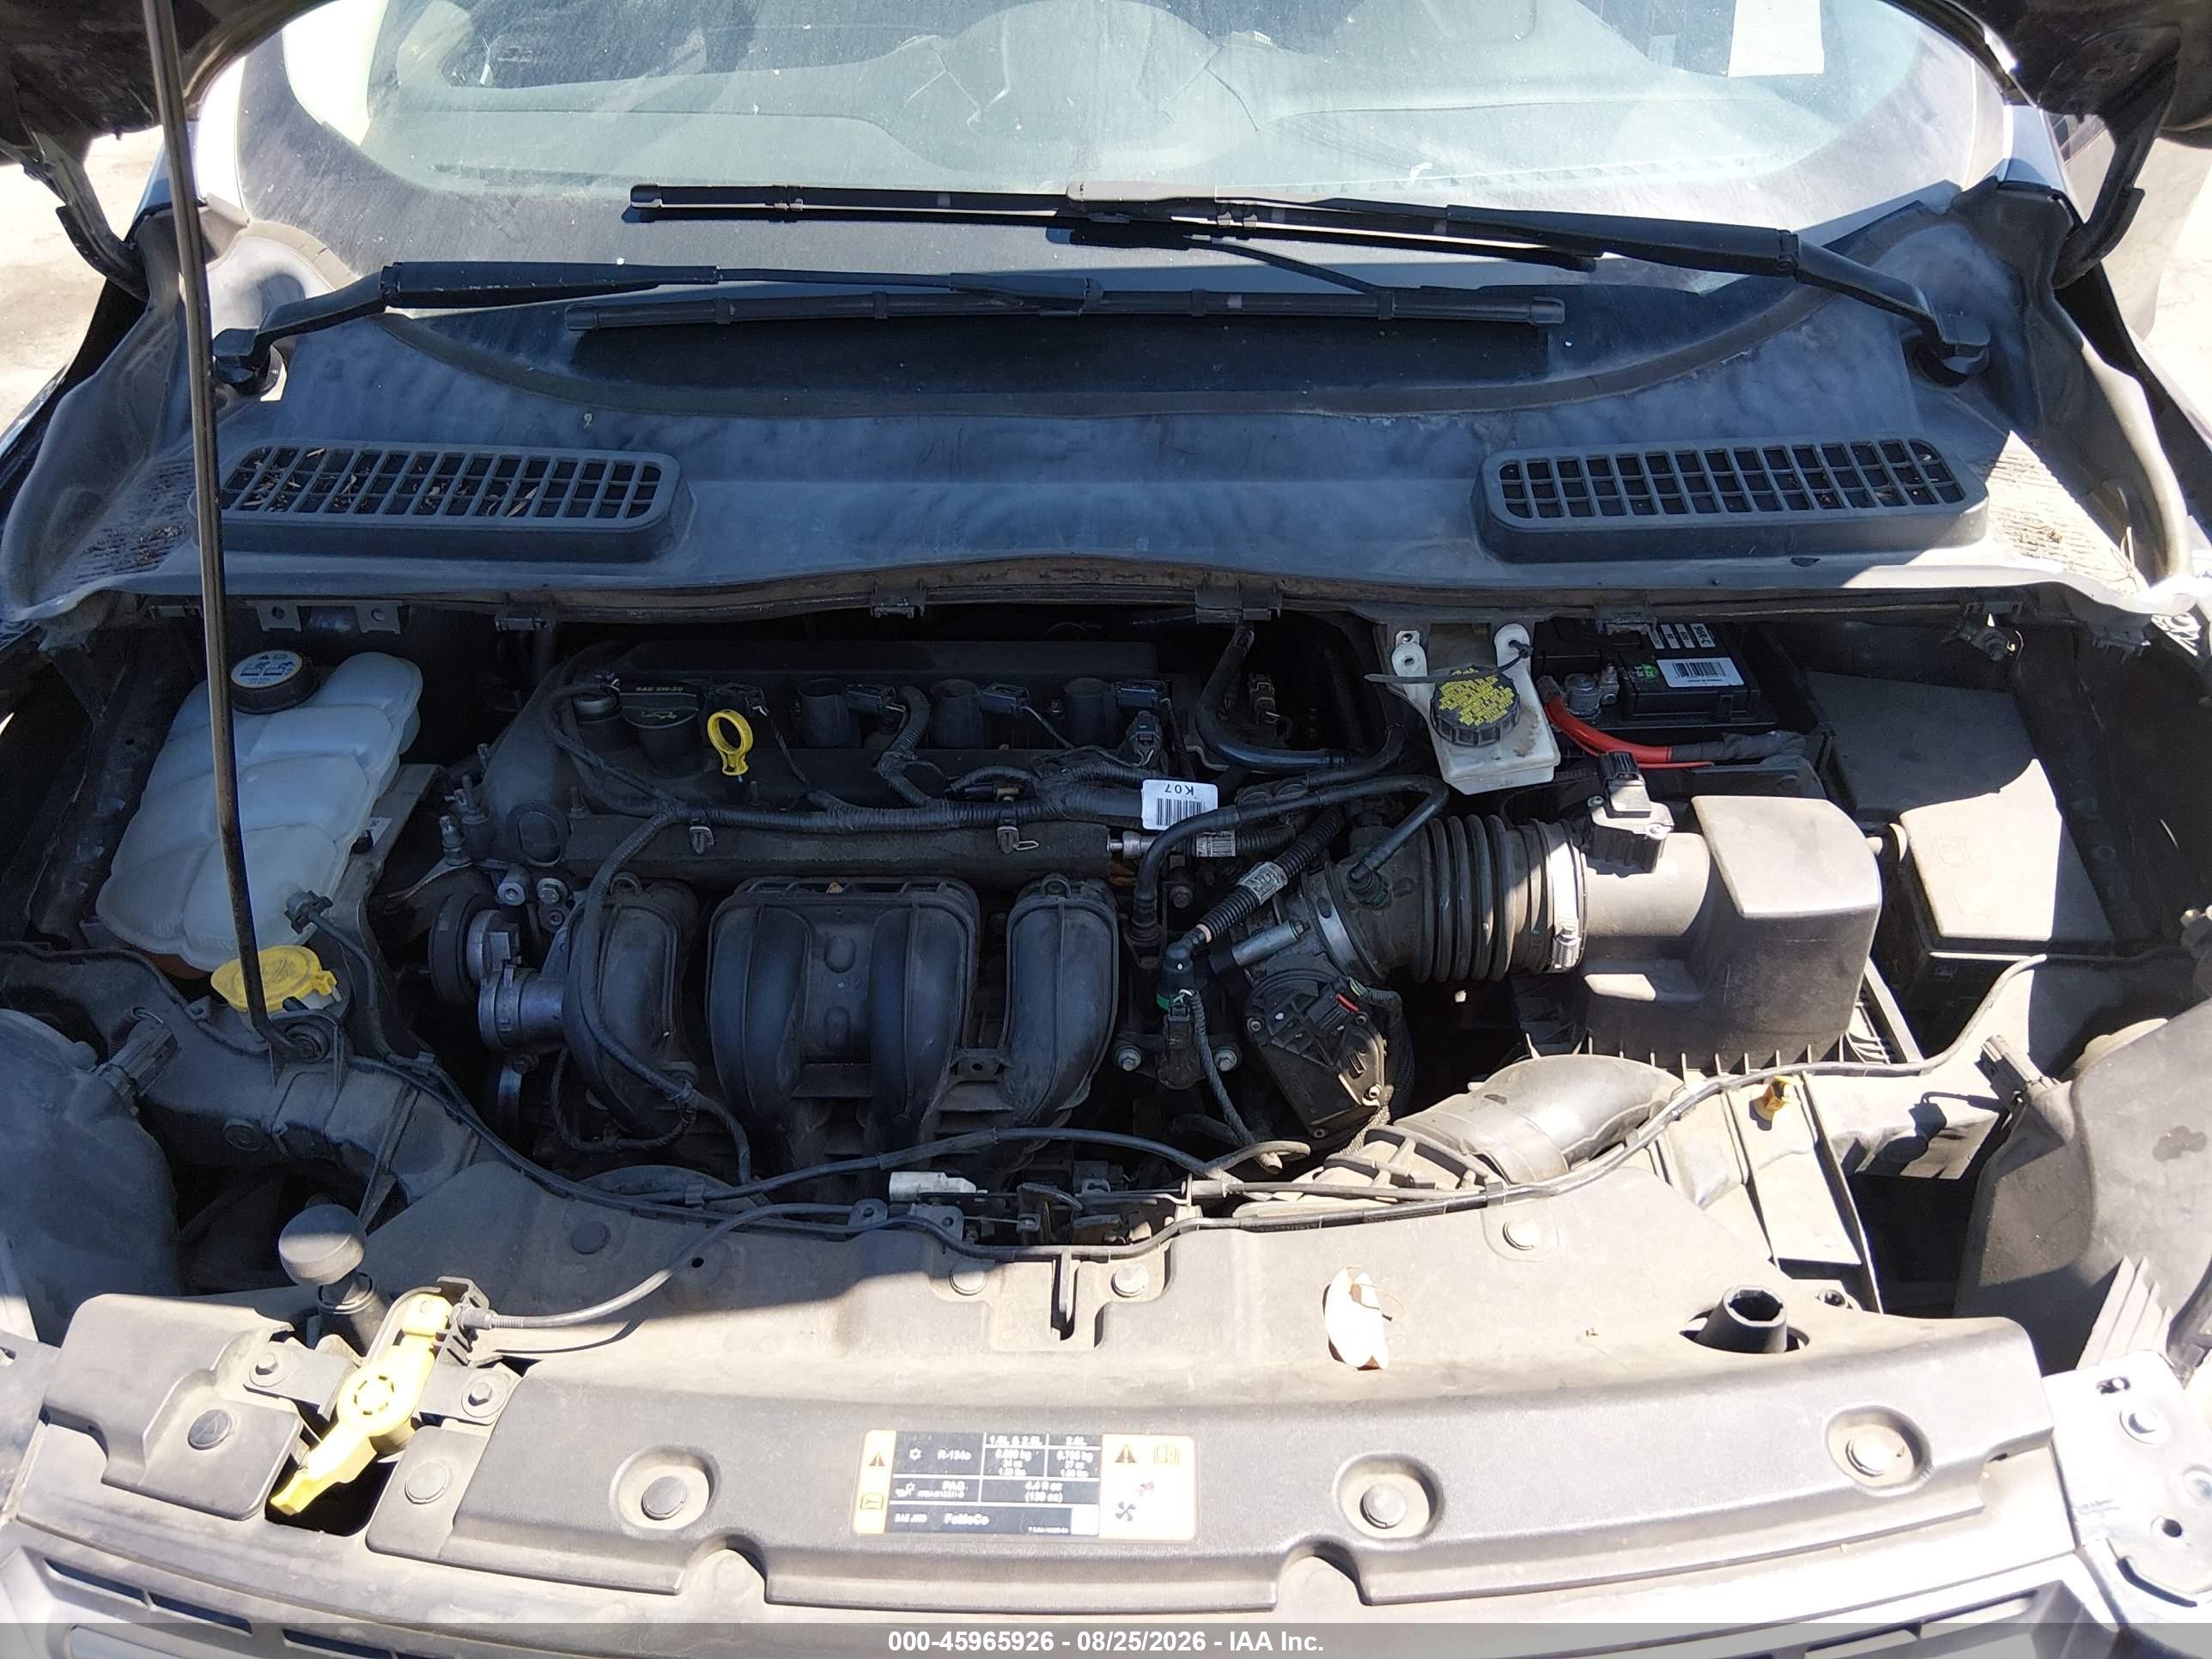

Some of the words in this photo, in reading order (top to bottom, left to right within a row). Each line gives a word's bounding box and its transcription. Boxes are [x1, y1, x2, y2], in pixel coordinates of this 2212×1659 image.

[1164, 783, 1194, 796] K07
[937, 1449, 971, 1461] R-134a
[944, 1512, 989, 1526] FoMoCo
